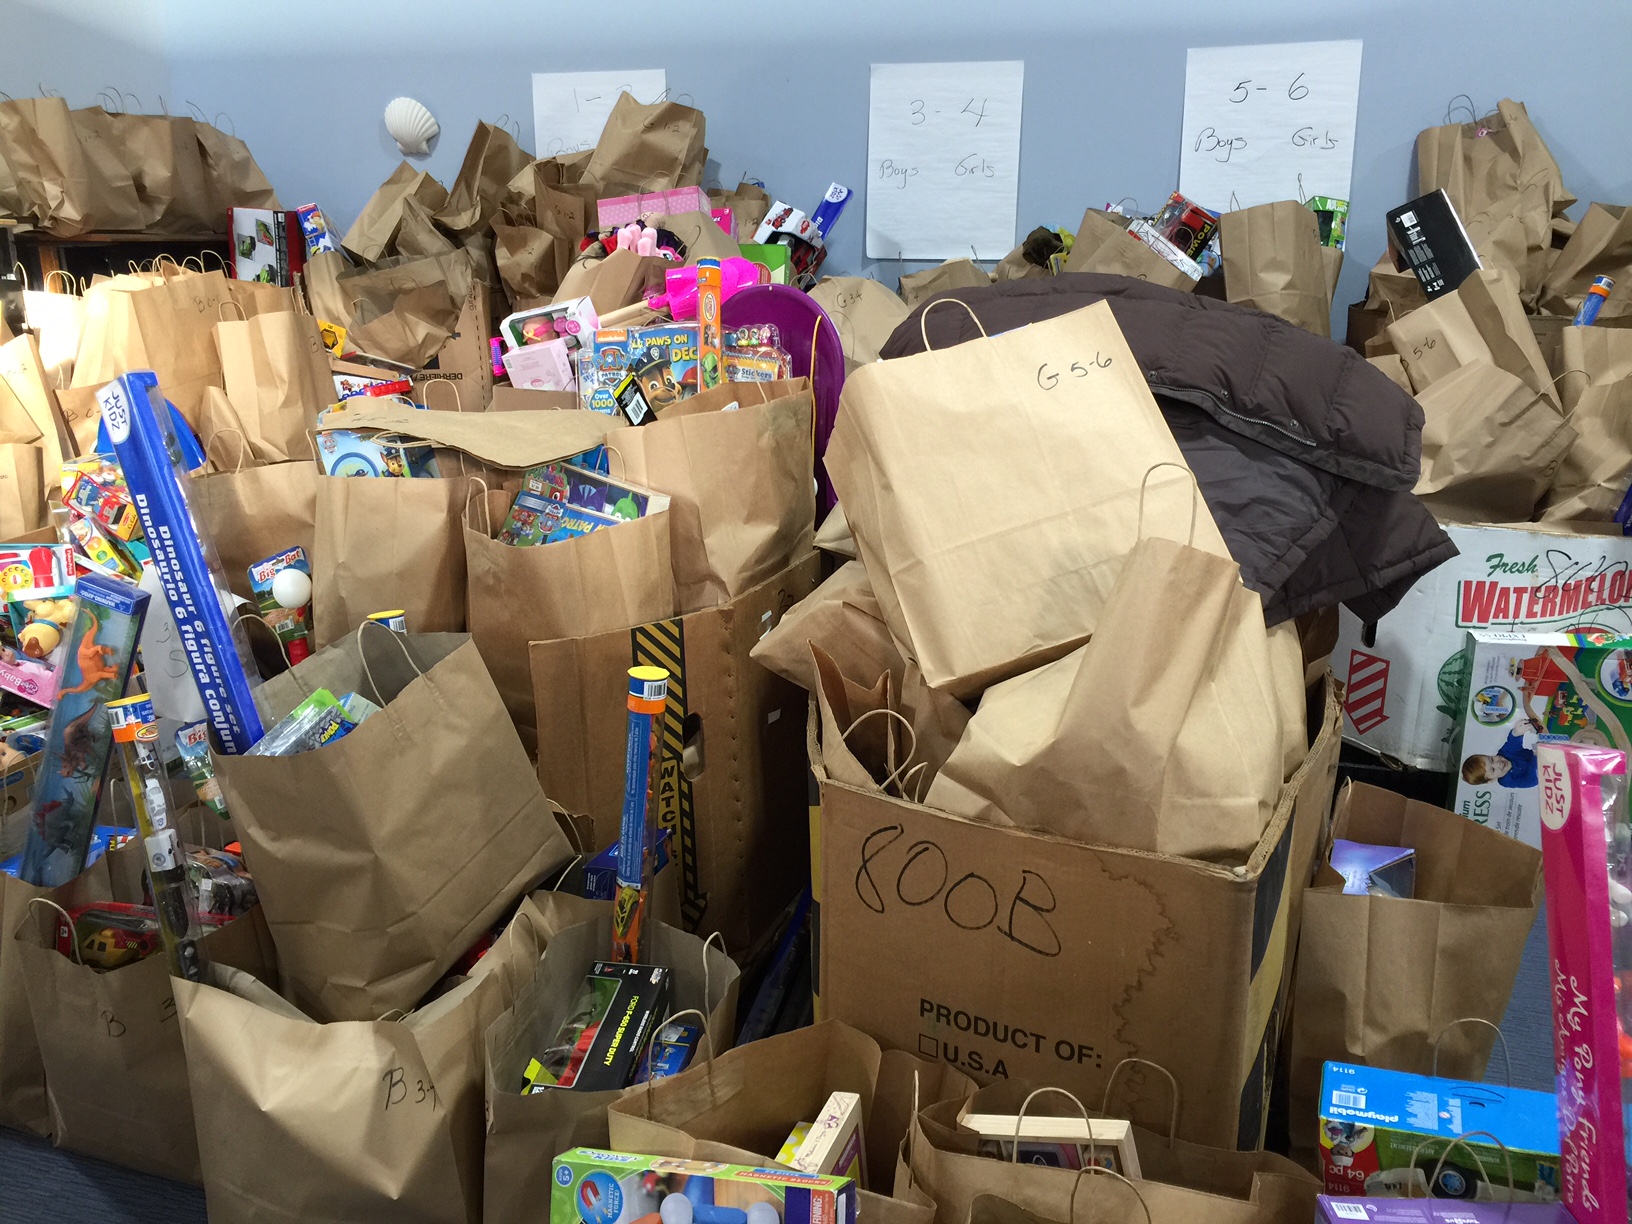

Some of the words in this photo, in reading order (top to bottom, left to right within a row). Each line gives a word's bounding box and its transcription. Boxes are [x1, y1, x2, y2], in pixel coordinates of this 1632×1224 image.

[1195, 127, 1248, 162] Boys
[1292, 127, 1338, 149] Girls
[879, 159, 919, 189] Boys
[955, 153, 994, 178] Girls
[645, 336, 672, 347] PAWS
[673, 334, 688, 344] ON
[1037, 363, 1060, 391] G
[1070, 351, 1113, 379] 5-6
[103, 396, 121, 431] KIDZ
[111, 391, 128, 426] JUST
[136, 494, 179, 602] Dinosaurio
[284, 549, 301, 565] Bat
[1485, 553, 1540, 578] Fresh
[258, 567, 276, 583] Big
[159, 525, 198, 615] Dinosaur
[194, 620, 206, 633] 6
[200, 638, 227, 698] figure
[225, 703, 242, 735] set
[175, 606, 189, 620] 6
[181, 624, 212, 684] figura
[205, 689, 239, 755] conjun
[1542, 763, 1554, 815] KIDZ
[1552, 762, 1565, 819] JUST
[1554, 958, 1567, 1006] Mis
[627, 994, 640, 1013] FORD
[1567, 975, 1589, 1032] My
[101, 1010, 126, 1037] B
[610, 1026, 627, 1050] SUPER
[919, 998, 1047, 1054] PRODUCT
[1054, 1039, 1102, 1069] OF:
[603, 1045, 618, 1067] DUTY
[943, 1042, 1010, 1080] U.S.A
[1332, 1066, 1356, 1075] 9114
[382, 1066, 408, 1111] B
[1571, 1043, 1594, 1106] Pony
[1329, 1106, 1399, 1123] playmobil
[1329, 1165, 1344, 1175] pc
[1347, 1168, 1365, 1181] 64
[1578, 1116, 1600, 1213] Friends
[607, 1182, 615, 1219] MAGNETIC
